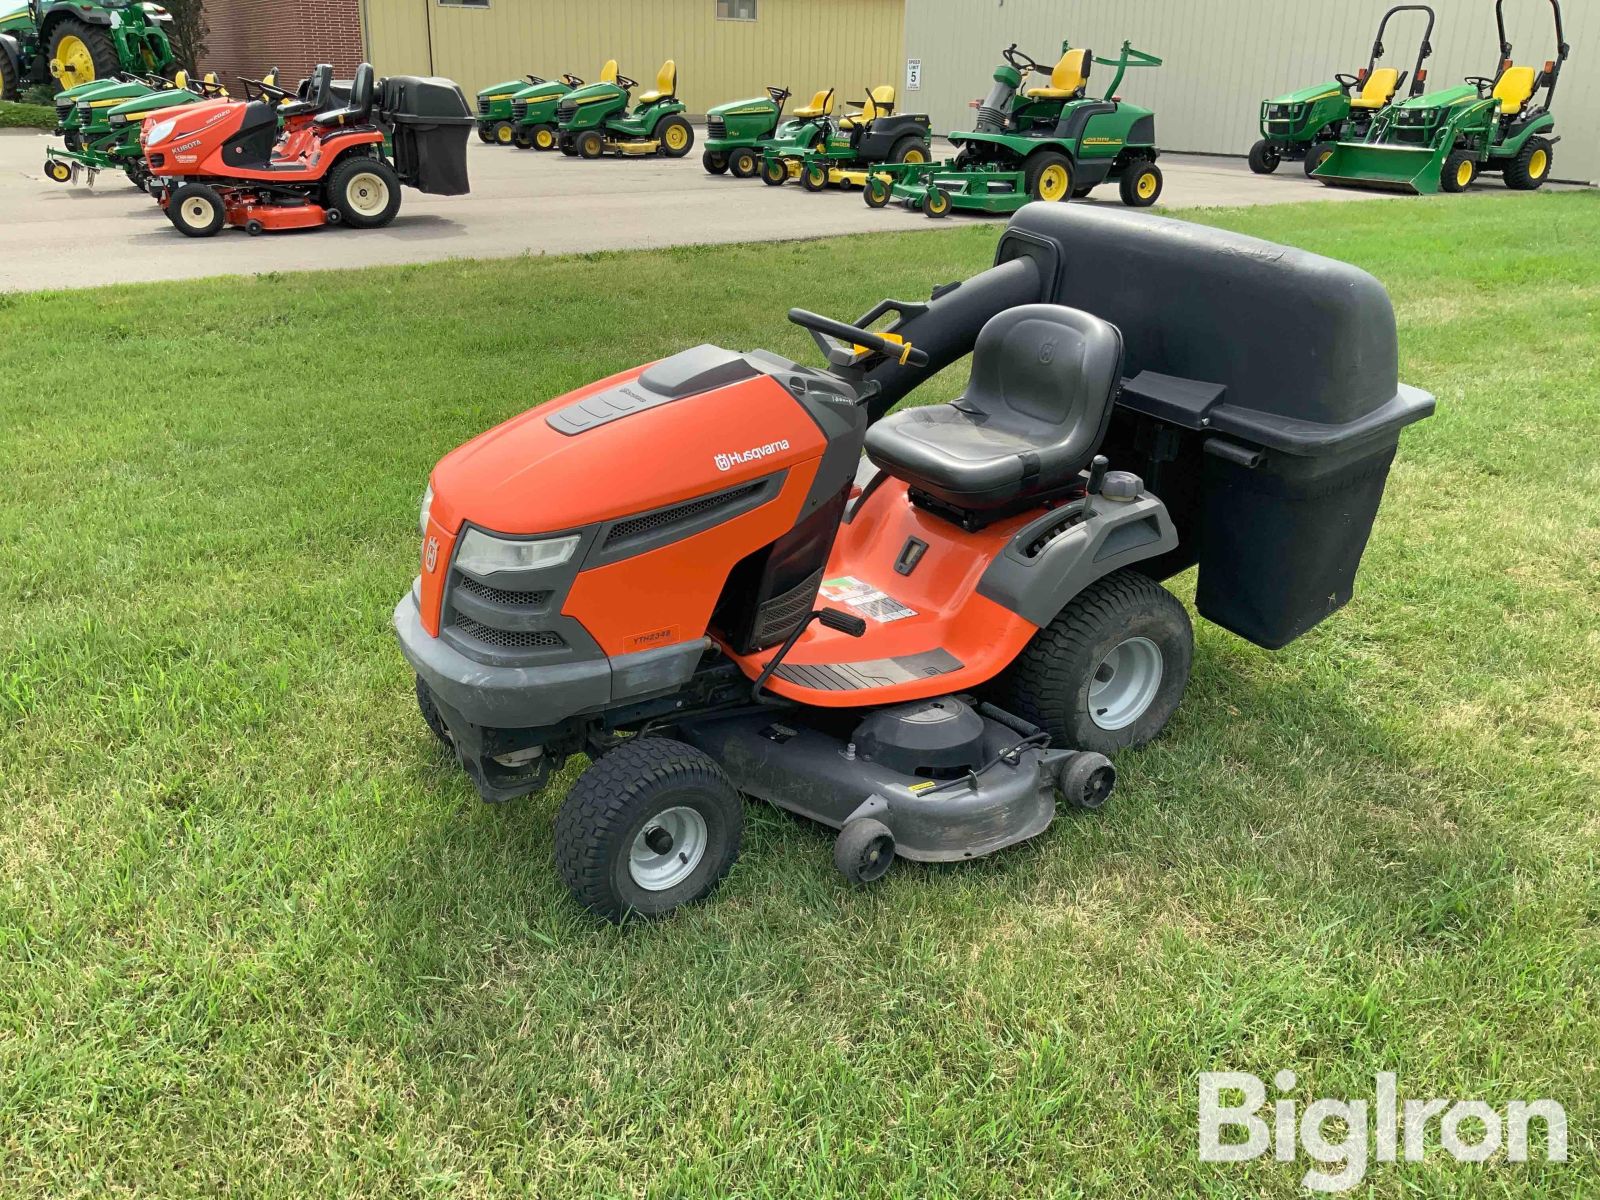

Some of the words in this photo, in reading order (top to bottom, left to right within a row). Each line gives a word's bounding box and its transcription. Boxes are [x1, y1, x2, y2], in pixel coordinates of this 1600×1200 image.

[911, 71, 917, 82] 5
[171, 139, 203, 154] KUBOTA
[728, 439, 790, 466] Husqvarna
